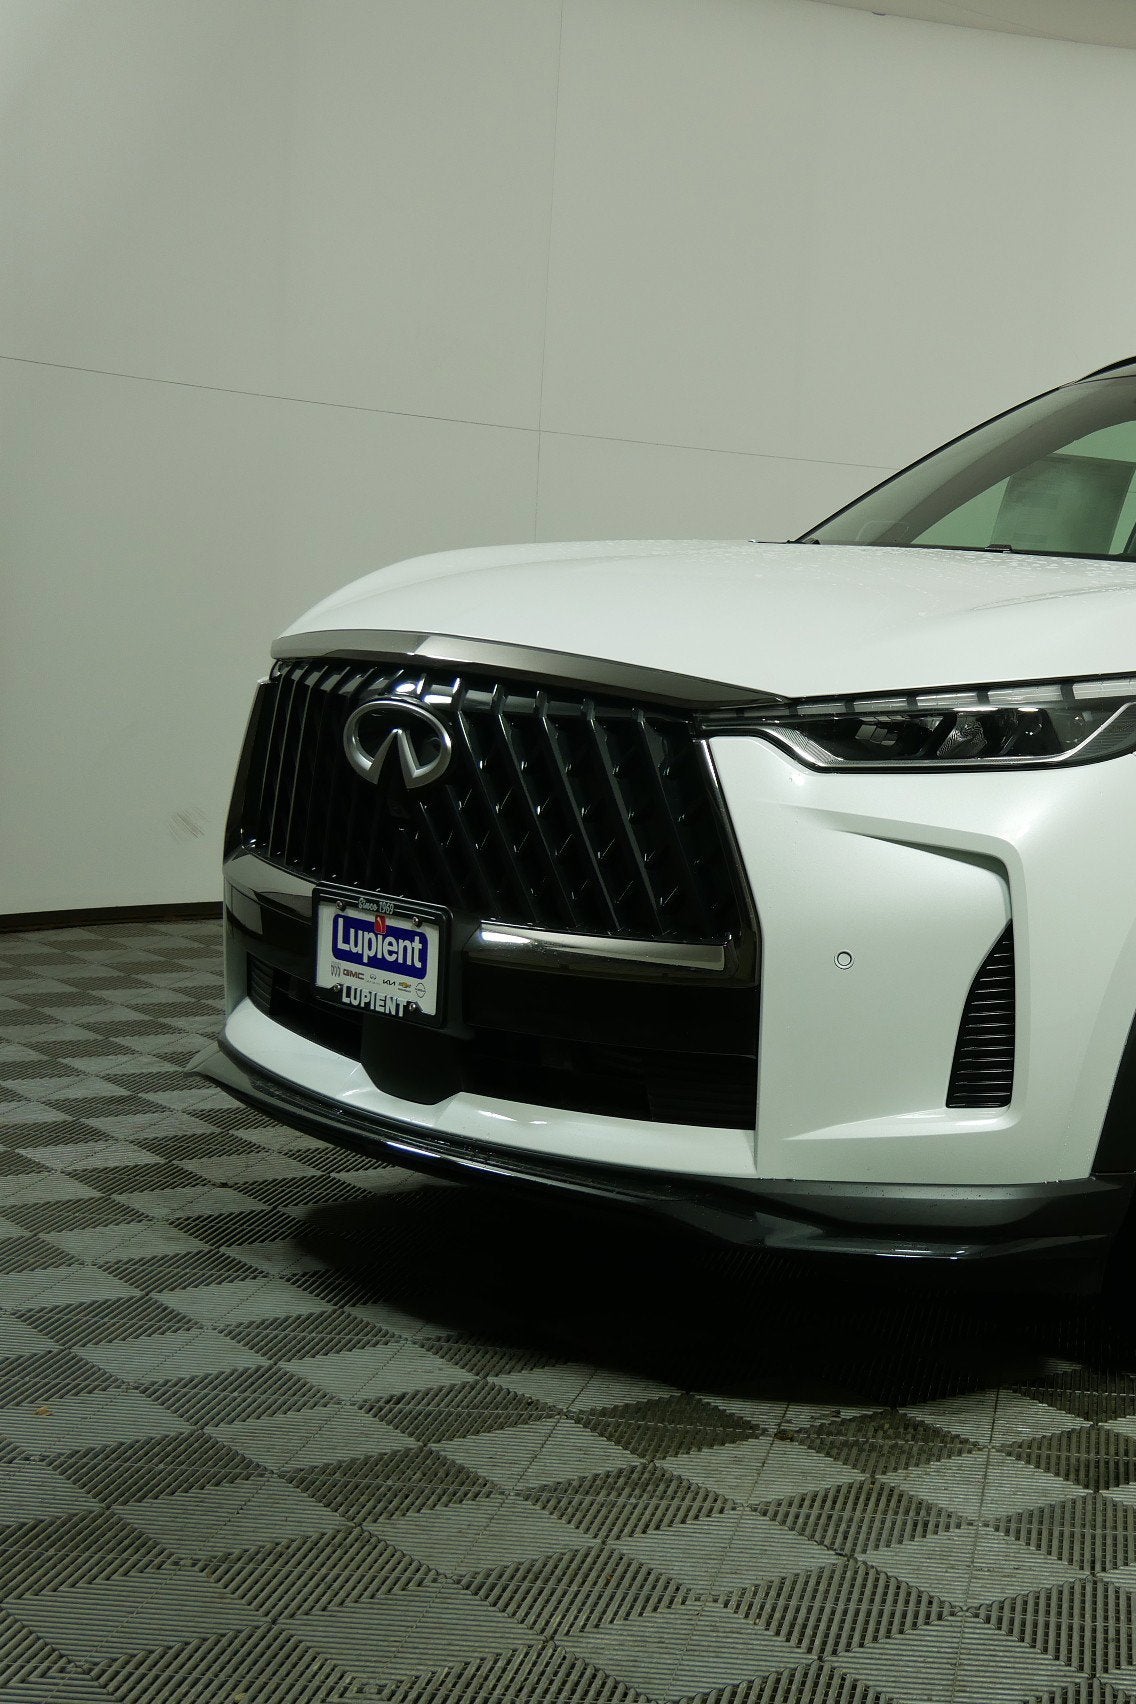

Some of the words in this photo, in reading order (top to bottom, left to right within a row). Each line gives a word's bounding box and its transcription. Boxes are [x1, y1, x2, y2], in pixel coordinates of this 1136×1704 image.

[337, 917, 423, 968] Lupient
[343, 969, 365, 980] GMC
[342, 984, 407, 1017] LUPIENT
